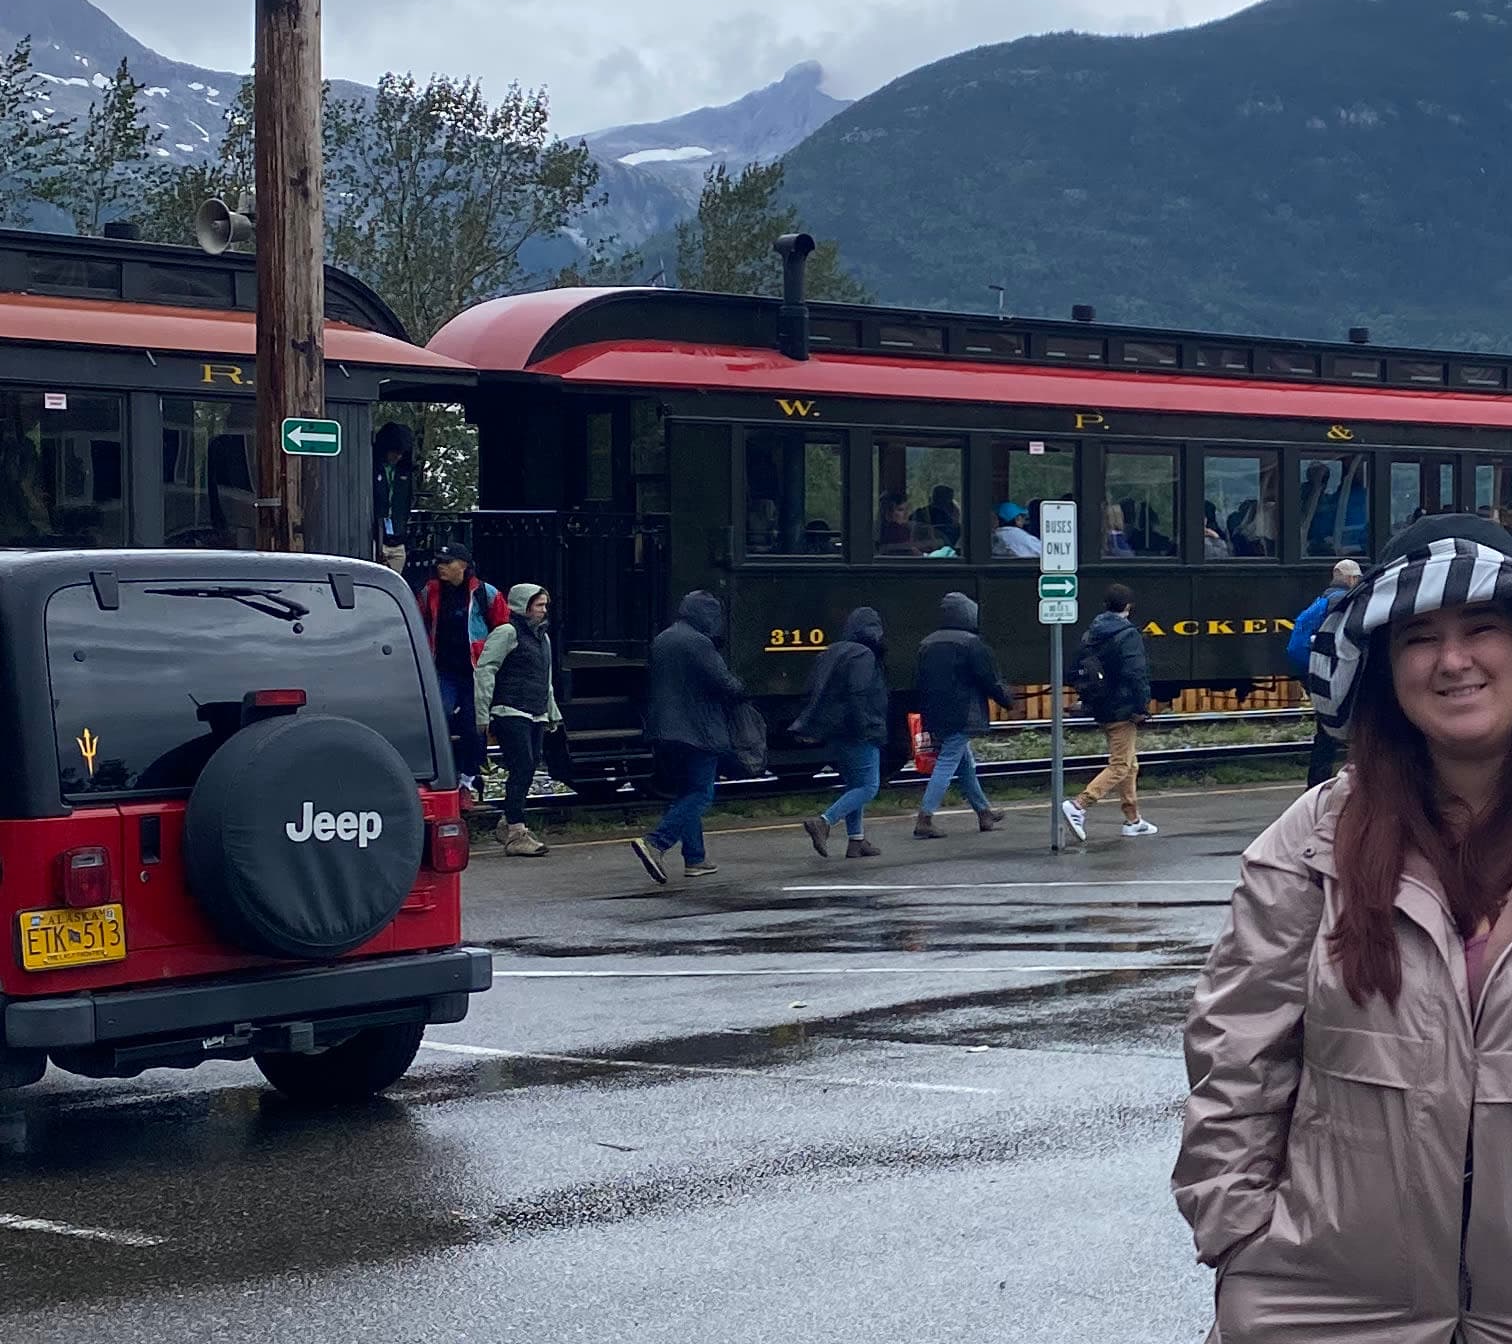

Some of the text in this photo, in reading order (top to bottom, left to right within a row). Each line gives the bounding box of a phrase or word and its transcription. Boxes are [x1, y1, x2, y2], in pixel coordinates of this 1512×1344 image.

[201, 363, 253, 385] R.
[775, 399, 820, 417] W.
[1074, 413, 1110, 430] P.
[1327, 425, 1354, 440] &
[1045, 520, 1072, 534] BUSES
[1046, 542, 1072, 555] ONLY
[770, 628, 824, 645] 310
[286, 802, 382, 847] Jeep
[48, 909, 99, 925] ALASKA
[27, 920, 120, 955] ETK 513
